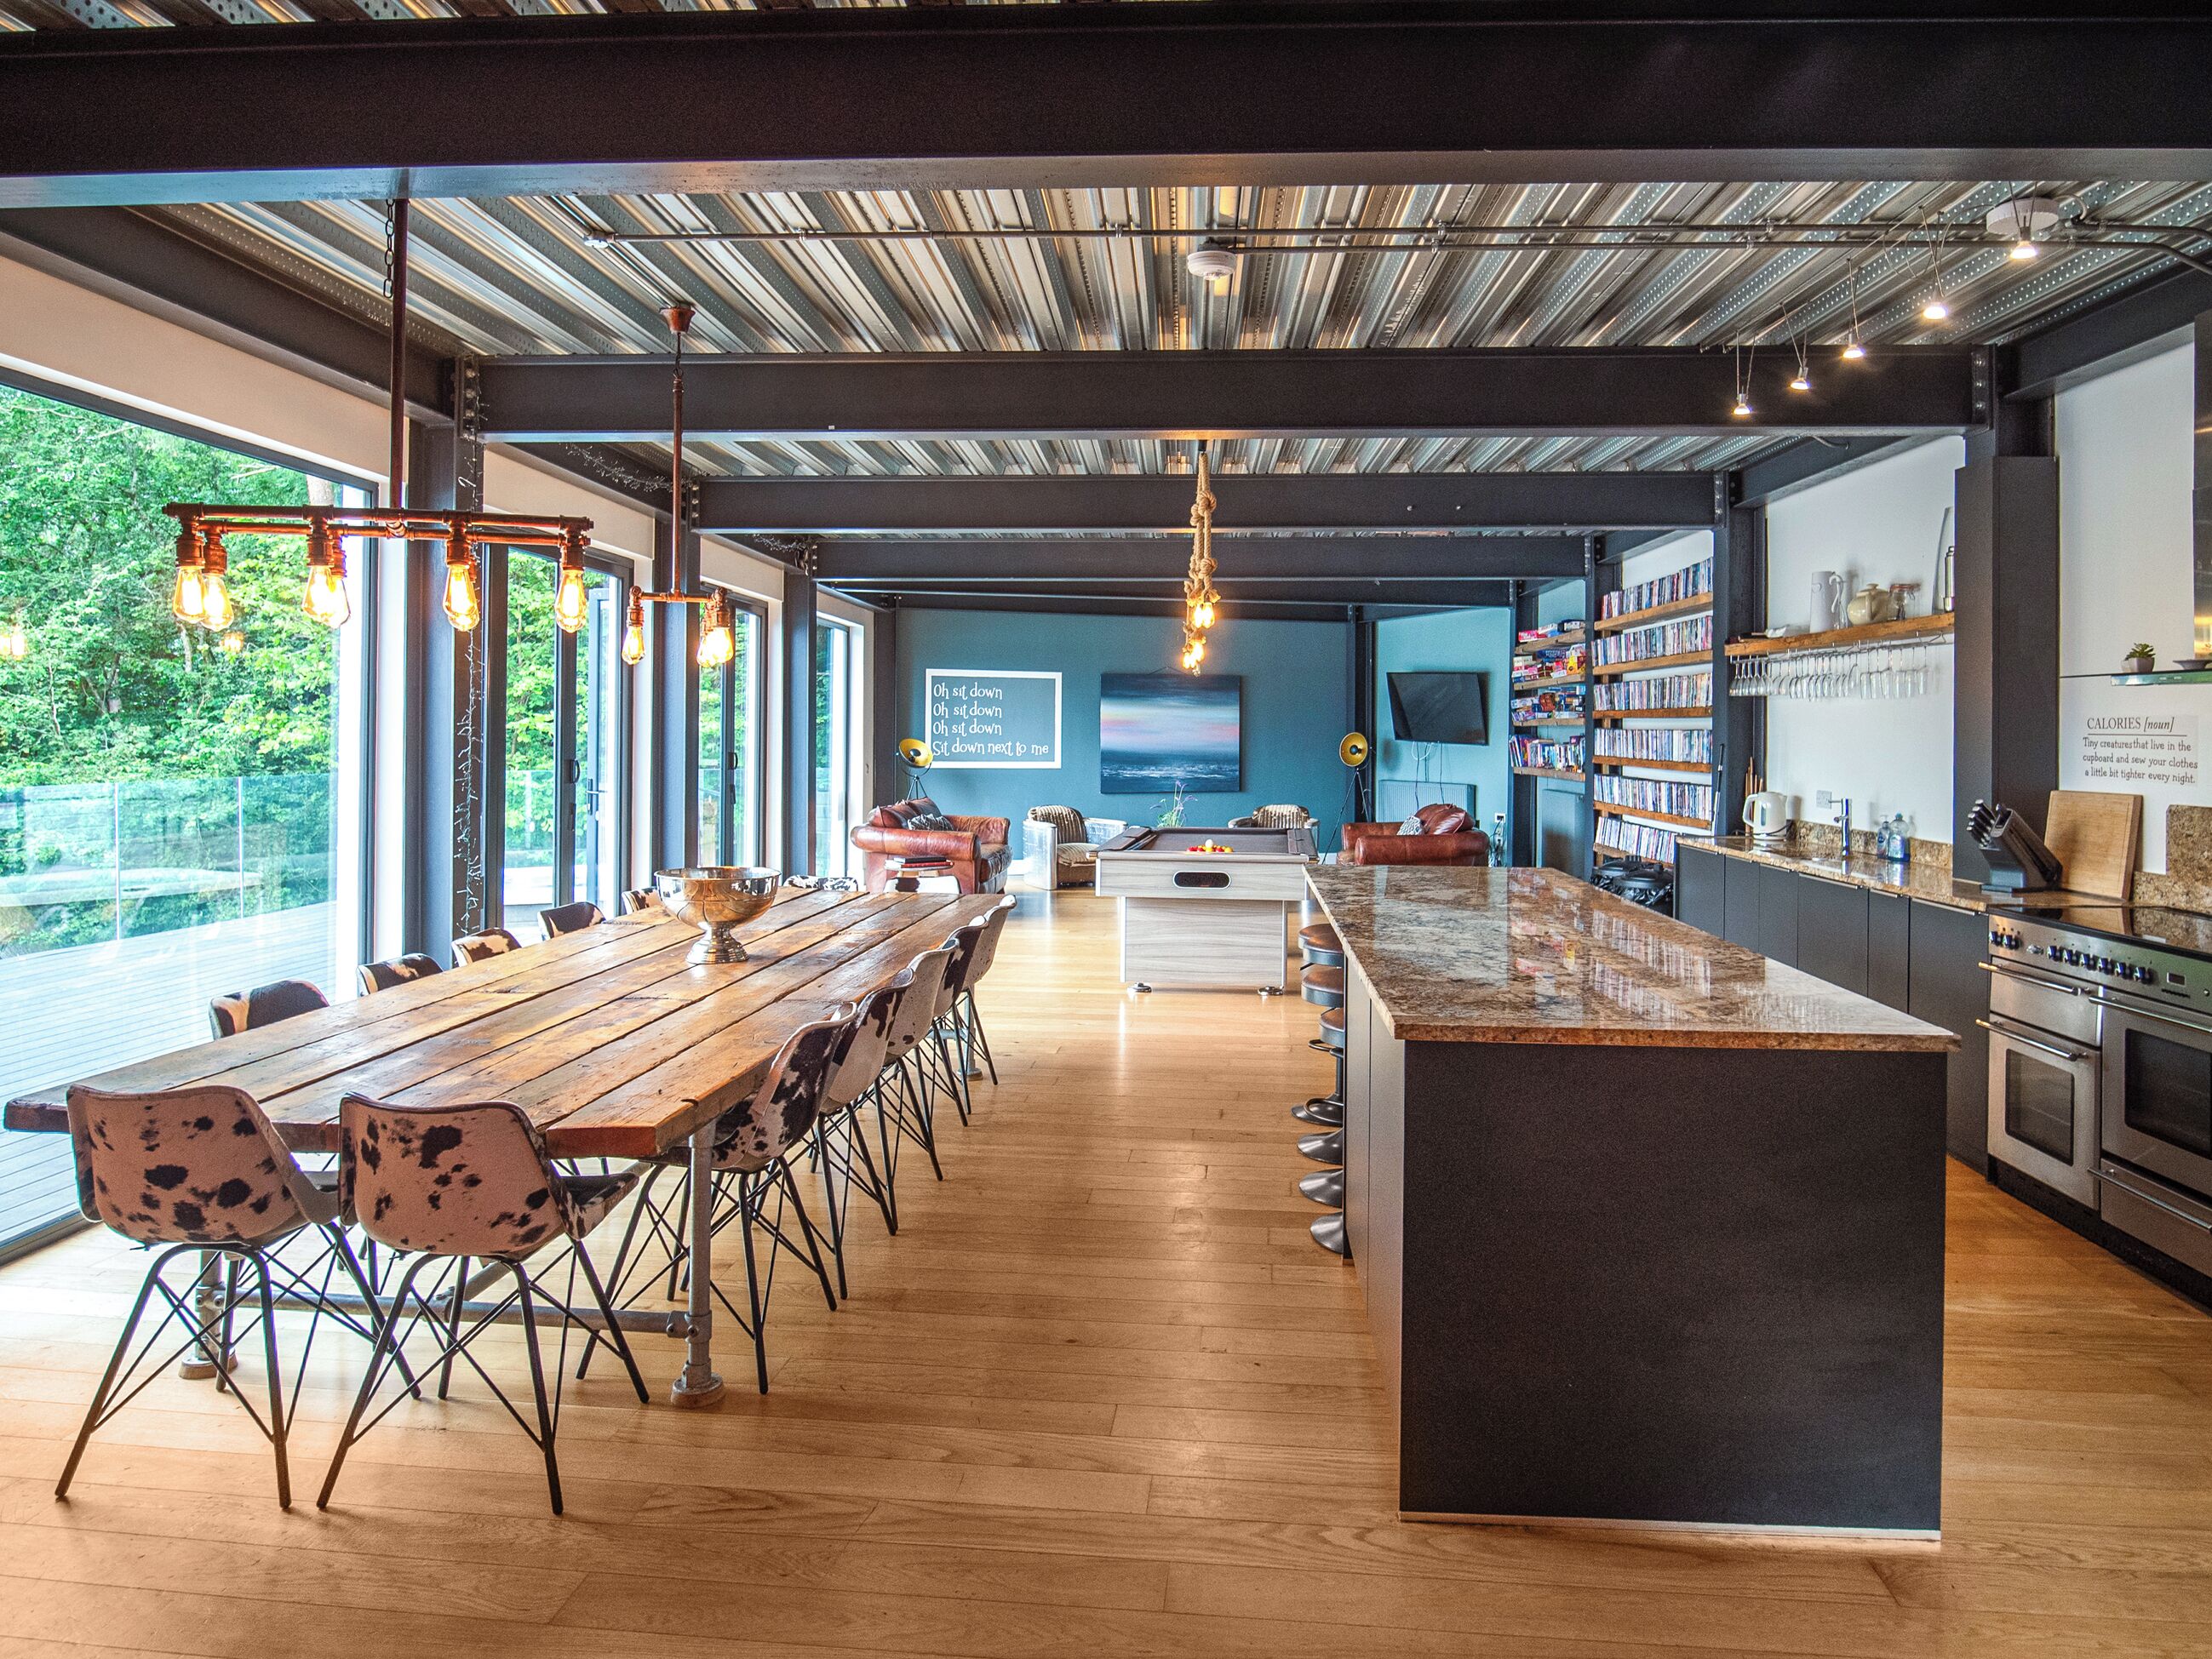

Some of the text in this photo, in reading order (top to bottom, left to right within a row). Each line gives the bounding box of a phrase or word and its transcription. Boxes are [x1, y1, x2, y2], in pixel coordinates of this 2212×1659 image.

[934, 682, 1002, 700] Oh sit down
[933, 701, 1002, 718] Oh sit down
[933, 718, 1001, 736] Oh sit down
[2087, 717, 2175, 732] CALORIES [noun]
[932, 738, 1048, 756] Sit down next to me
[2083, 737, 2191, 751] Tiny creatures that live in the
[2083, 752, 2113, 764] cupboard
[2116, 753, 2129, 764] and
[2148, 758, 2166, 767] your
[2169, 758, 2198, 769] clothes
[2091, 767, 2107, 776] little
[2109, 769, 2118, 778] bit
[2121, 769, 2146, 781] tighter
[2148, 773, 2170, 783] every
[2173, 773, 2195, 785] night.
